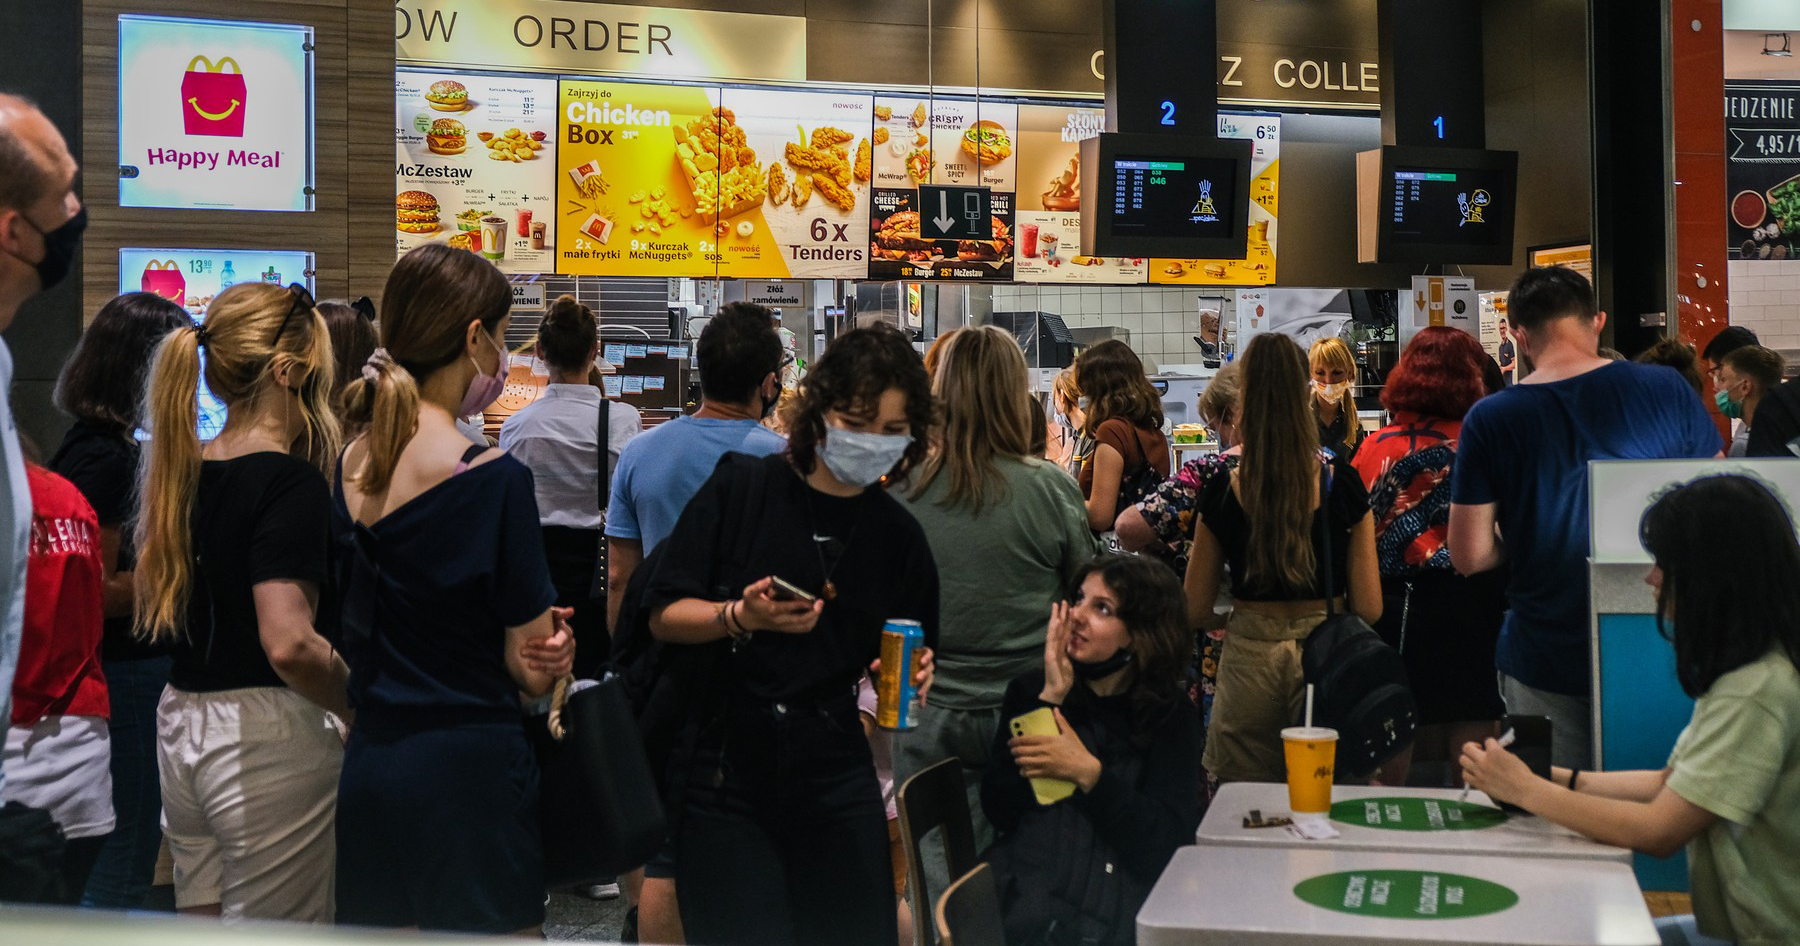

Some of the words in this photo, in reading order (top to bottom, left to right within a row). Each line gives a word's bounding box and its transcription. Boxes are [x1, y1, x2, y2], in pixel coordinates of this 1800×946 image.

[513, 14, 673, 56] ORDER
[1273, 58, 1379, 92] COLLE
[568, 88, 598, 100] Zajrzyj
[600, 89, 612, 98] do
[567, 102, 670, 126] Chicken
[1160, 100, 1176, 126] 2
[1724, 96, 1795, 119] JEDZENIE
[928, 115, 964, 124] CRISPY
[1067, 113, 1105, 129] SŁONY
[1433, 116, 1444, 138] 1
[568, 124, 614, 145] Box
[1256, 126, 1265, 139] 6
[147, 147, 220, 170] Happy
[227, 148, 280, 168] Meal
[1150, 177, 1167, 185] 046
[648, 242, 689, 251] Kurczak
[728, 244, 760, 253] nowość
[790, 244, 863, 261] Tenders
[564, 250, 590, 259] małe
[592, 250, 620, 261] frytki
[704, 253, 723, 261] sos
[914, 268, 935, 278] Burger
[953, 268, 983, 277] McZestaw
